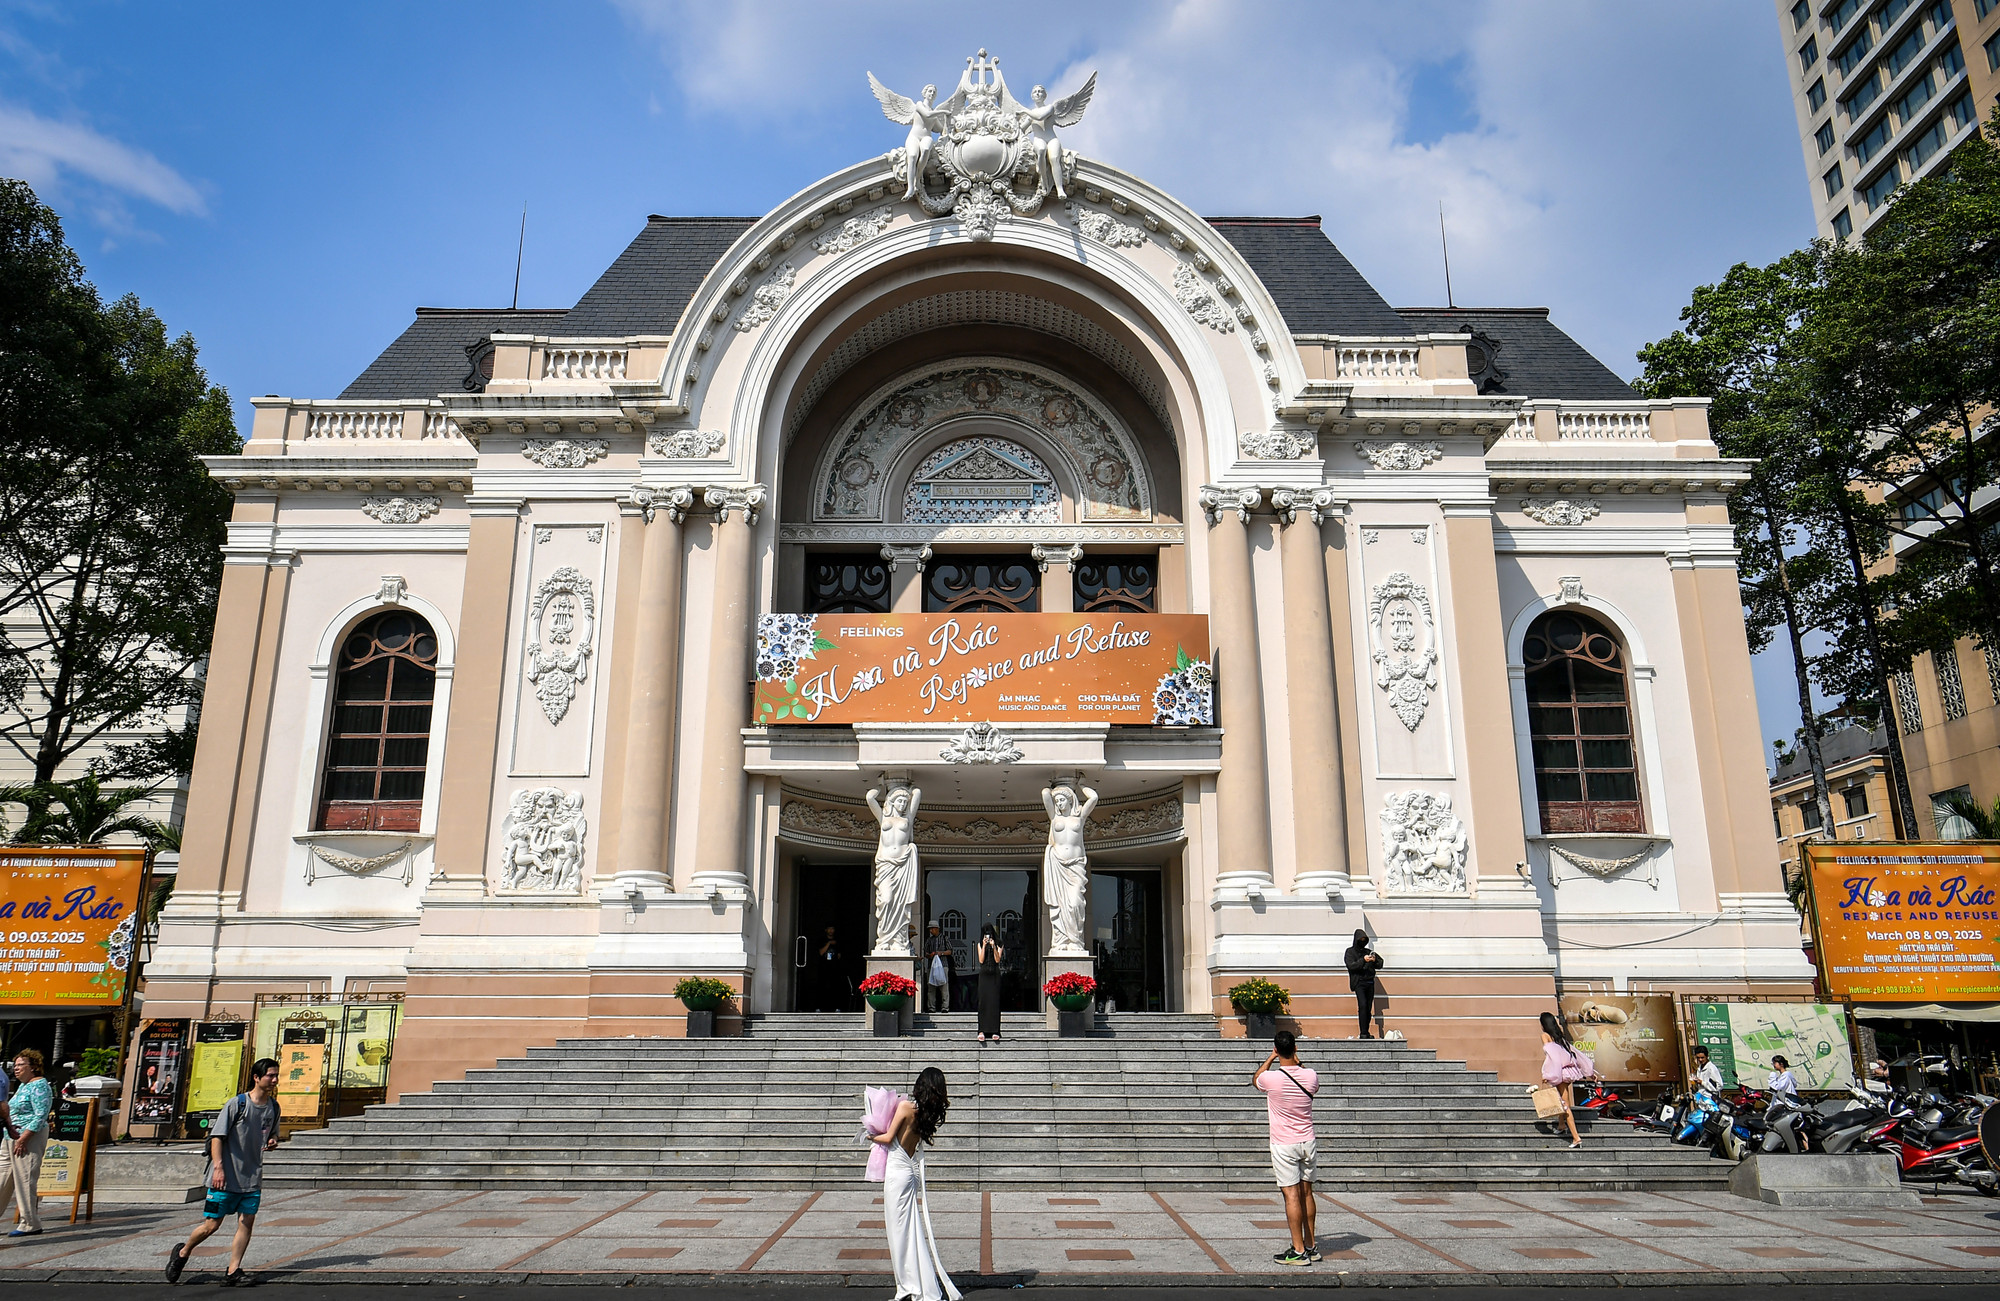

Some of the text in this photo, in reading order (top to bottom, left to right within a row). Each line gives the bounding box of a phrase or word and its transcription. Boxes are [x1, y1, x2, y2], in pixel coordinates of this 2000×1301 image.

[840, 627, 904, 637] FEELINGS
[892, 646, 922, 678] và
[928, 618, 999, 666] Rác
[920, 621, 1150, 715] Rejoice and Refuse
[998, 694, 1040, 704] ÂM NHẠC
[1100, 693, 1121, 702] TRÁI
[1122, 693, 1141, 702] ĐẤT
[2, 858, 8, 866] &
[70, 858, 116, 867] FOUNDATION
[1836, 856, 1870, 865] FEELINGS
[1871, 856, 1877, 865] &
[1938, 855, 1984, 864] FOUNDATION
[1908, 885, 1932, 905] và
[1936, 876, 1995, 907] Rác
[21, 896, 51, 919] và
[53, 885, 123, 921] Rác
[1843, 911, 1999, 921] REJOICE AND REFUSE
[9, 932, 85, 943] 09.03.2025
[1866, 930, 1983, 941] March 08 & 09, 2025
[9, 949, 24, 958] CHO
[26, 948, 44, 958] TRÁI
[1912, 944, 1925, 952] CHO
[39, 962, 55, 972] CHO
